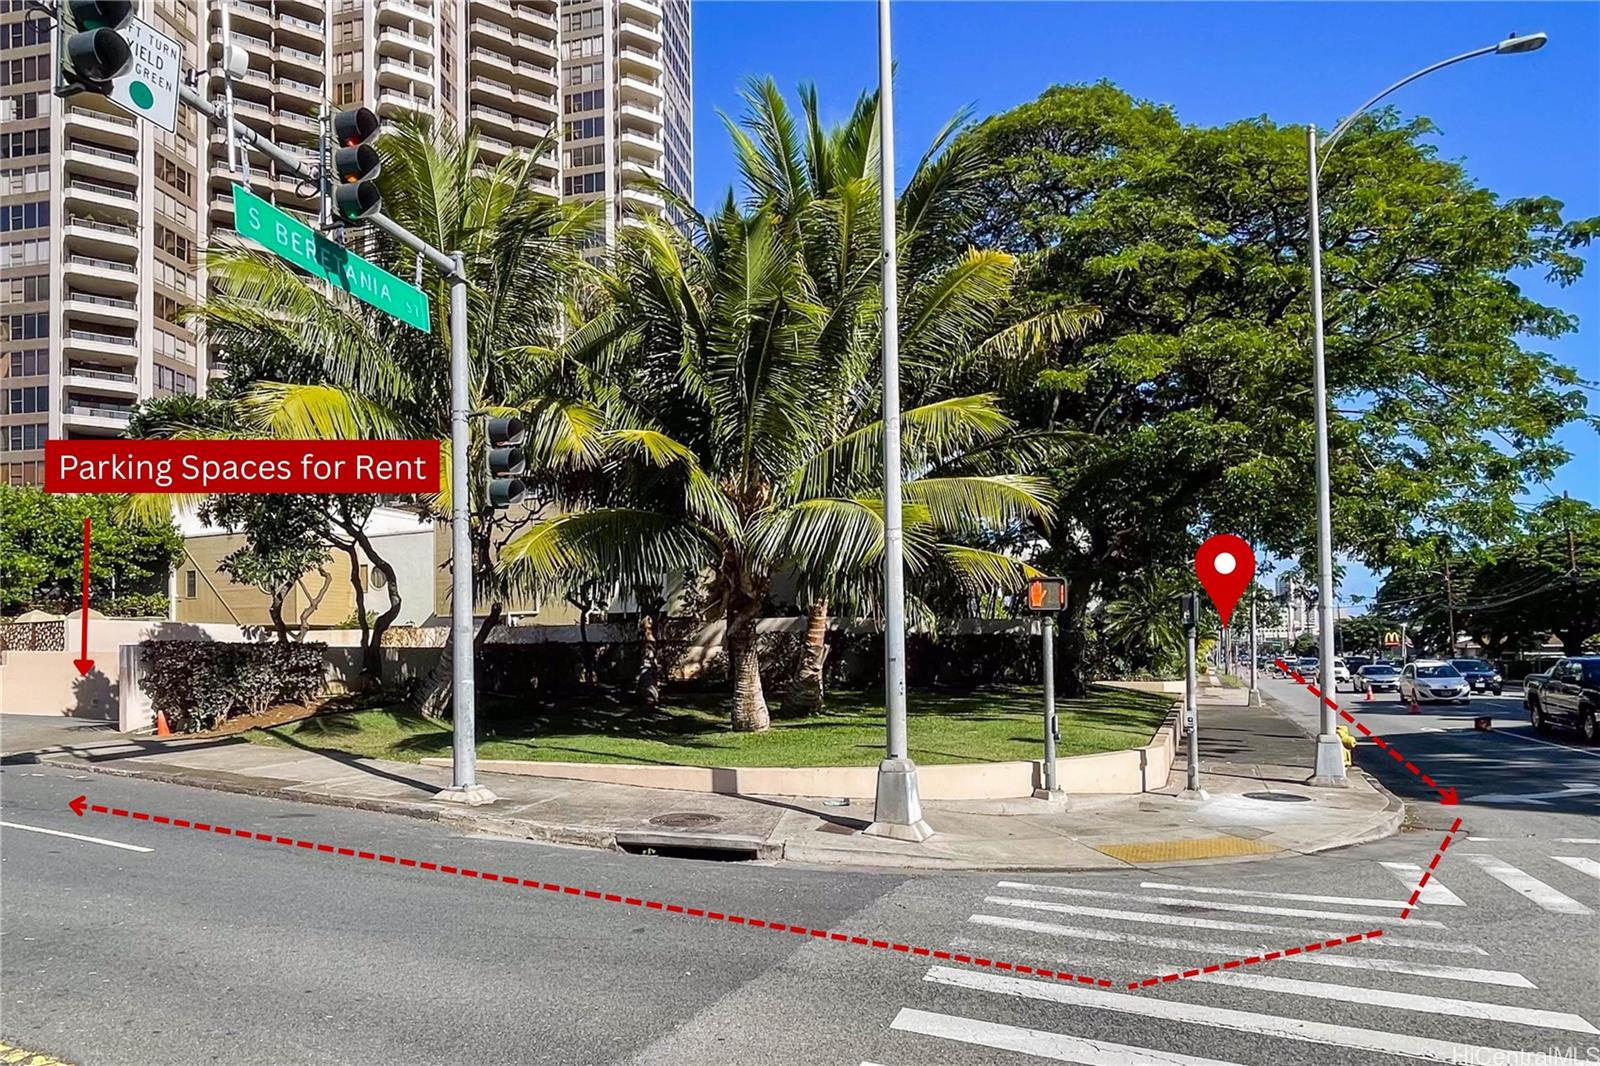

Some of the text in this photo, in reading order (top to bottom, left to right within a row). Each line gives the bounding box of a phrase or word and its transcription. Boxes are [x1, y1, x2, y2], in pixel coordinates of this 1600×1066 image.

[127, 37, 164, 71] YIELD
[149, 34, 177, 60] TURN
[135, 63, 172, 92] GREEN
[248, 207, 261, 231] S
[275, 221, 393, 304] BERETANIA
